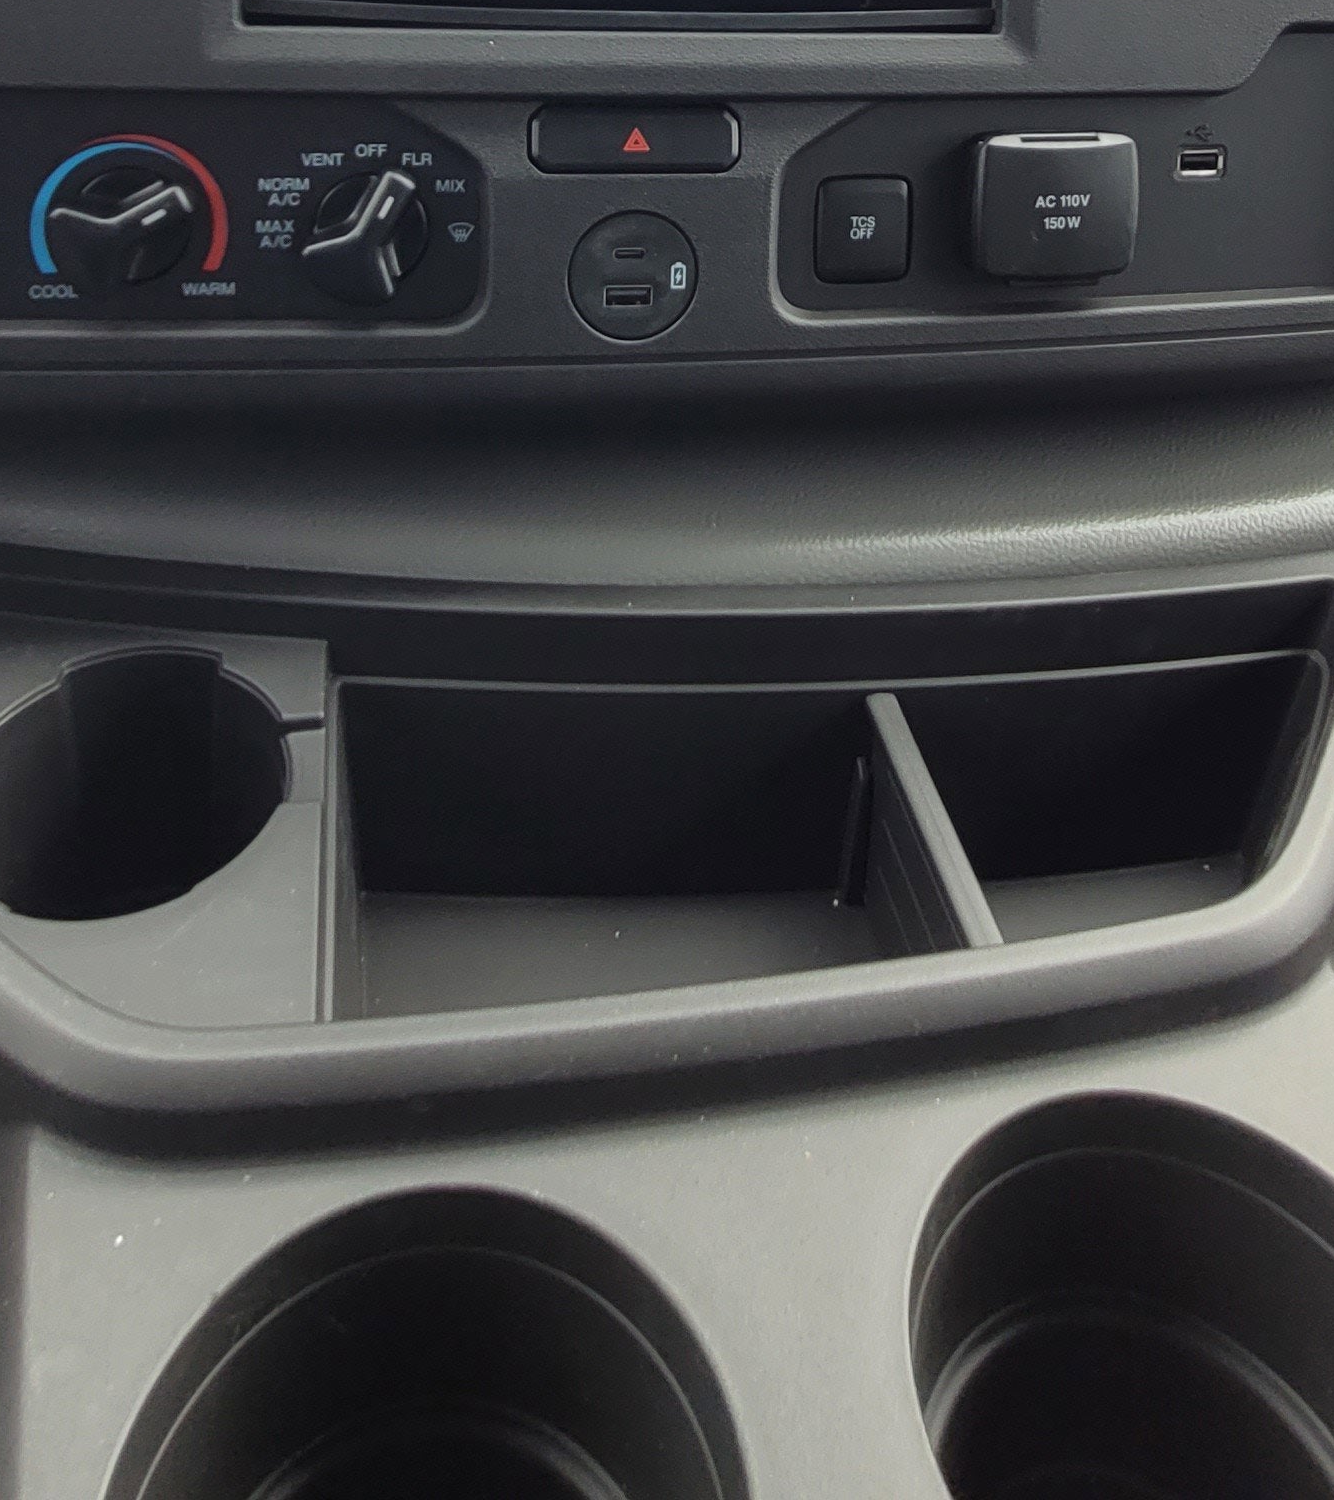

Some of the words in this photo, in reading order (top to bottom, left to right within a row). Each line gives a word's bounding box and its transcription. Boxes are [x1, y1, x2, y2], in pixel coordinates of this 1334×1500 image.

[355, 143, 388, 159] OFF
[301, 152, 345, 168] VENT
[402, 152, 433, 167] FLR
[257, 177, 310, 193] NORM
[436, 178, 466, 194] MIX
[268, 192, 301, 207] A/C
[1034, 194, 1057, 209] AC
[1060, 193, 1092, 208] 110V
[255, 219, 295, 235] MAX
[850, 215, 876, 228] TCS
[260, 233, 293, 249] A/C
[849, 227, 874, 241] OFF
[28, 284, 79, 299] COOL
[181, 281, 236, 296] WARM
